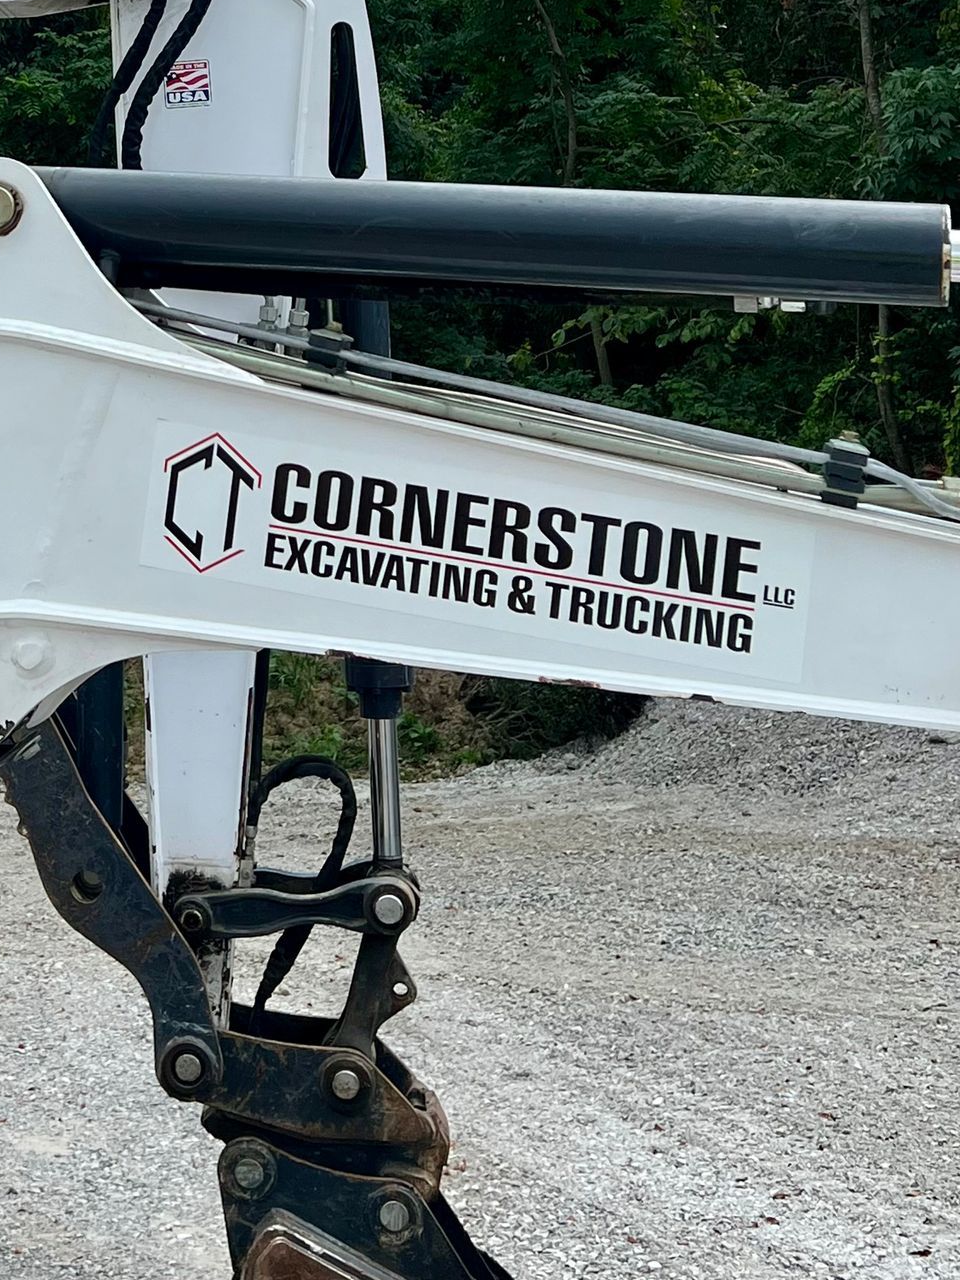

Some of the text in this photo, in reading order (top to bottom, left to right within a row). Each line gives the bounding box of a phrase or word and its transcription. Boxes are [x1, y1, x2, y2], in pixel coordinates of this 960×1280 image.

[169, 91, 207, 103] USA
[264, 534, 754, 654] EXCAVATING & TRUCKING
[269, 462, 796, 608] CORNERSTONE LLC
